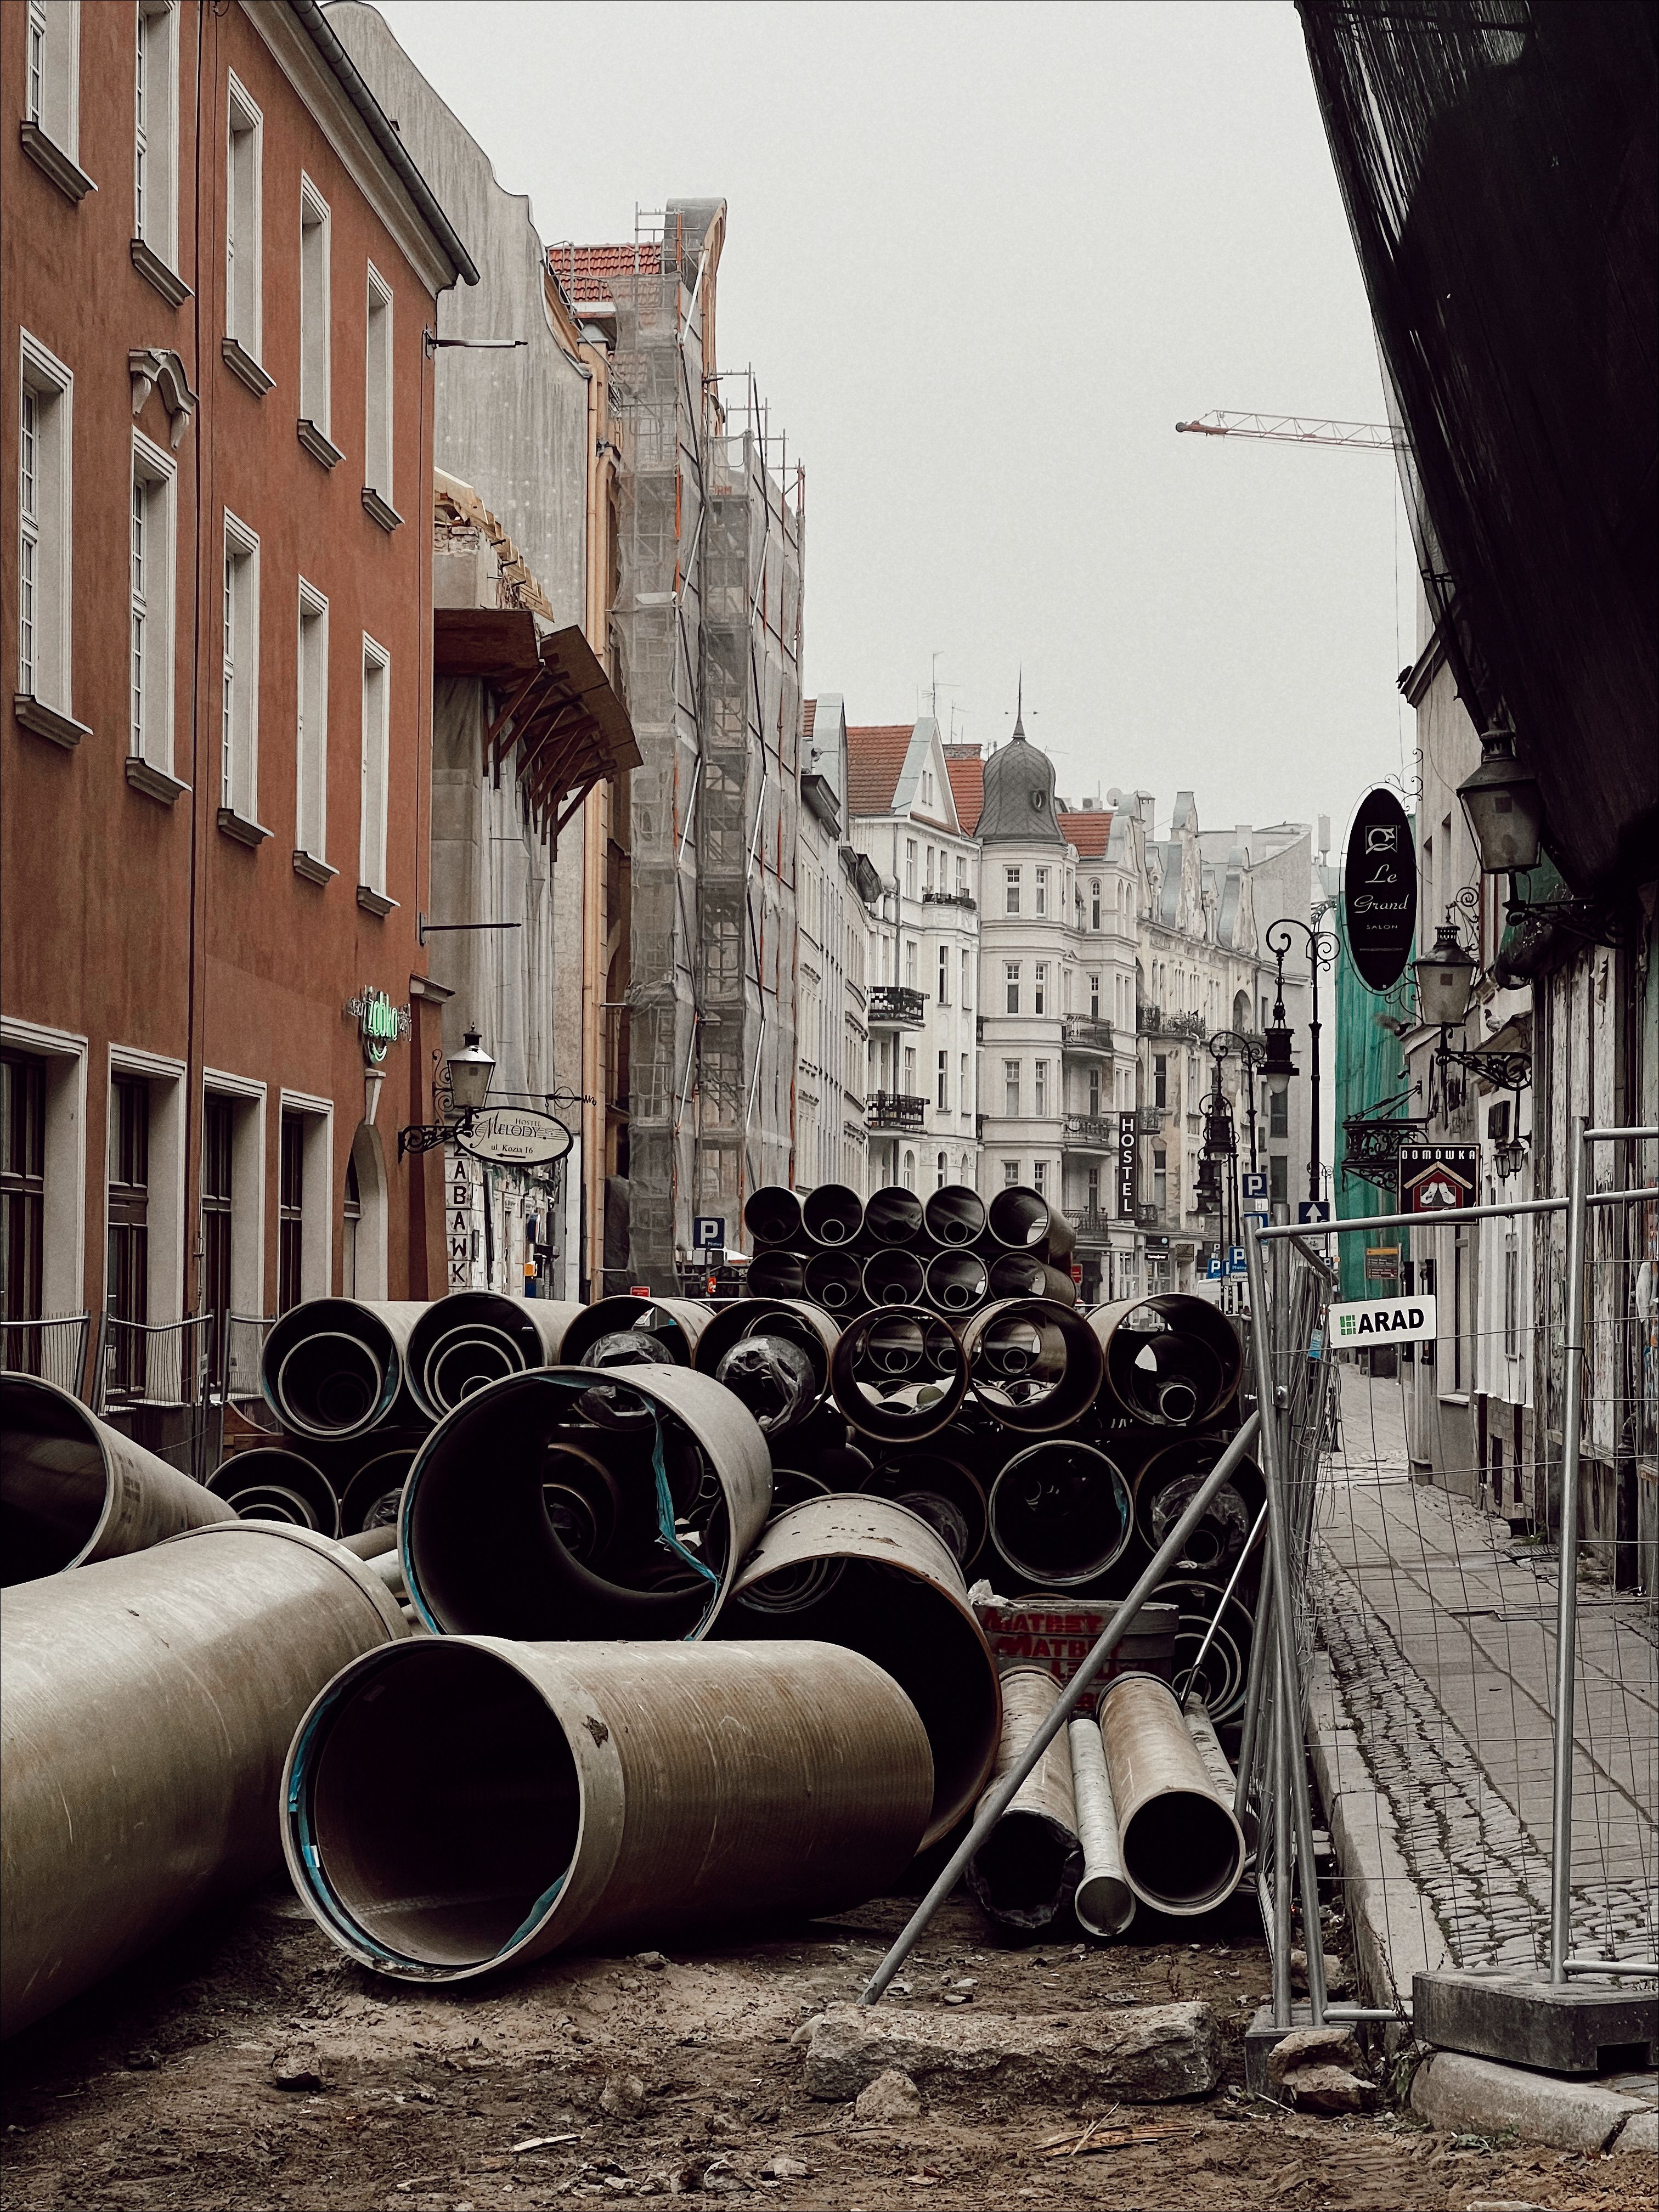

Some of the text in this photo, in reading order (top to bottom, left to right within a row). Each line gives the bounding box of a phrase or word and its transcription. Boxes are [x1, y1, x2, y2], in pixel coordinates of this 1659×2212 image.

[1364, 864, 1398, 883] Le
[1353, 894, 1409, 913] Grand
[515, 1118, 540, 1126] HOSTEL
[502, 1144, 522, 1153] Kozia
[1402, 1148, 1475, 1160] DOMÓWKA
[1121, 1118, 1135, 1212] HOSTEL
[1248, 1176, 1262, 1195] P
[701, 1220, 718, 1245] P
[1234, 1248, 1245, 1264] P
[1211, 1260, 1221, 1273] P
[1358, 1308, 1424, 1334] ARAD
